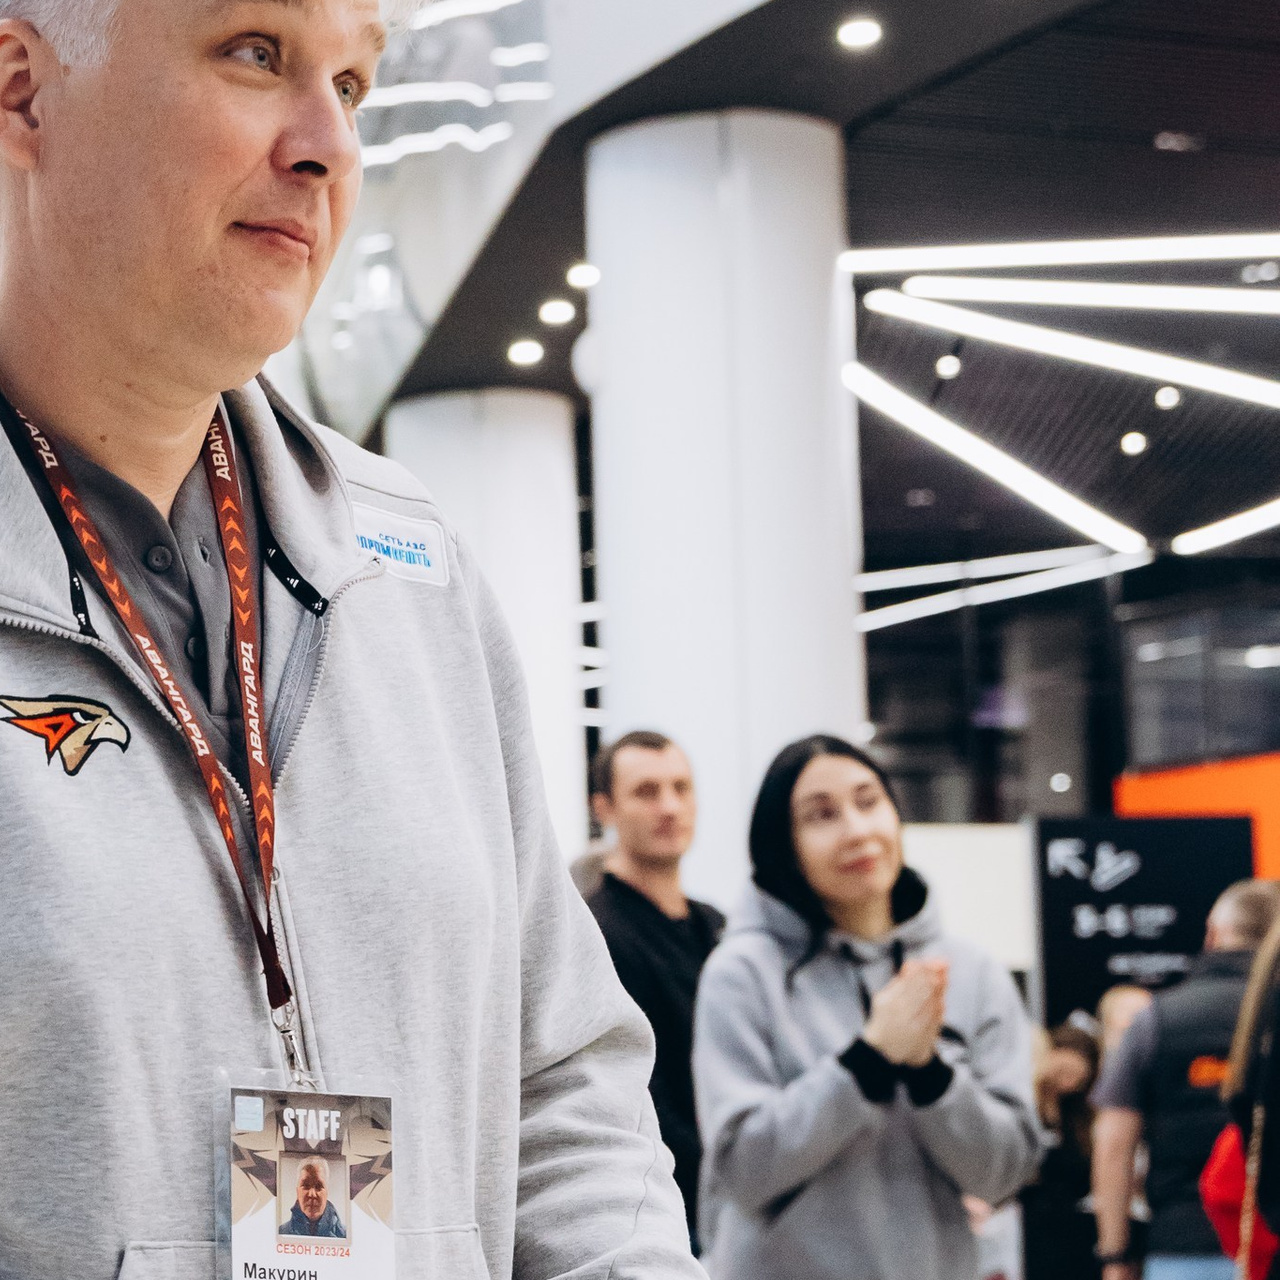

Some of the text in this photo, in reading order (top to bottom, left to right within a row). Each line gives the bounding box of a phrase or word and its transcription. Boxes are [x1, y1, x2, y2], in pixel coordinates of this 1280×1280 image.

[15, 409, 59, 468] АРД
[378, 532, 403, 547] СЕТЬ
[134, 633, 211, 757] АВАНГАРД
[240, 640, 267, 768] АВАНГАРД
[282, 1107, 342, 1141] STAFF
[276, 1243, 351, 1258] СЕЗОН 2023/24
